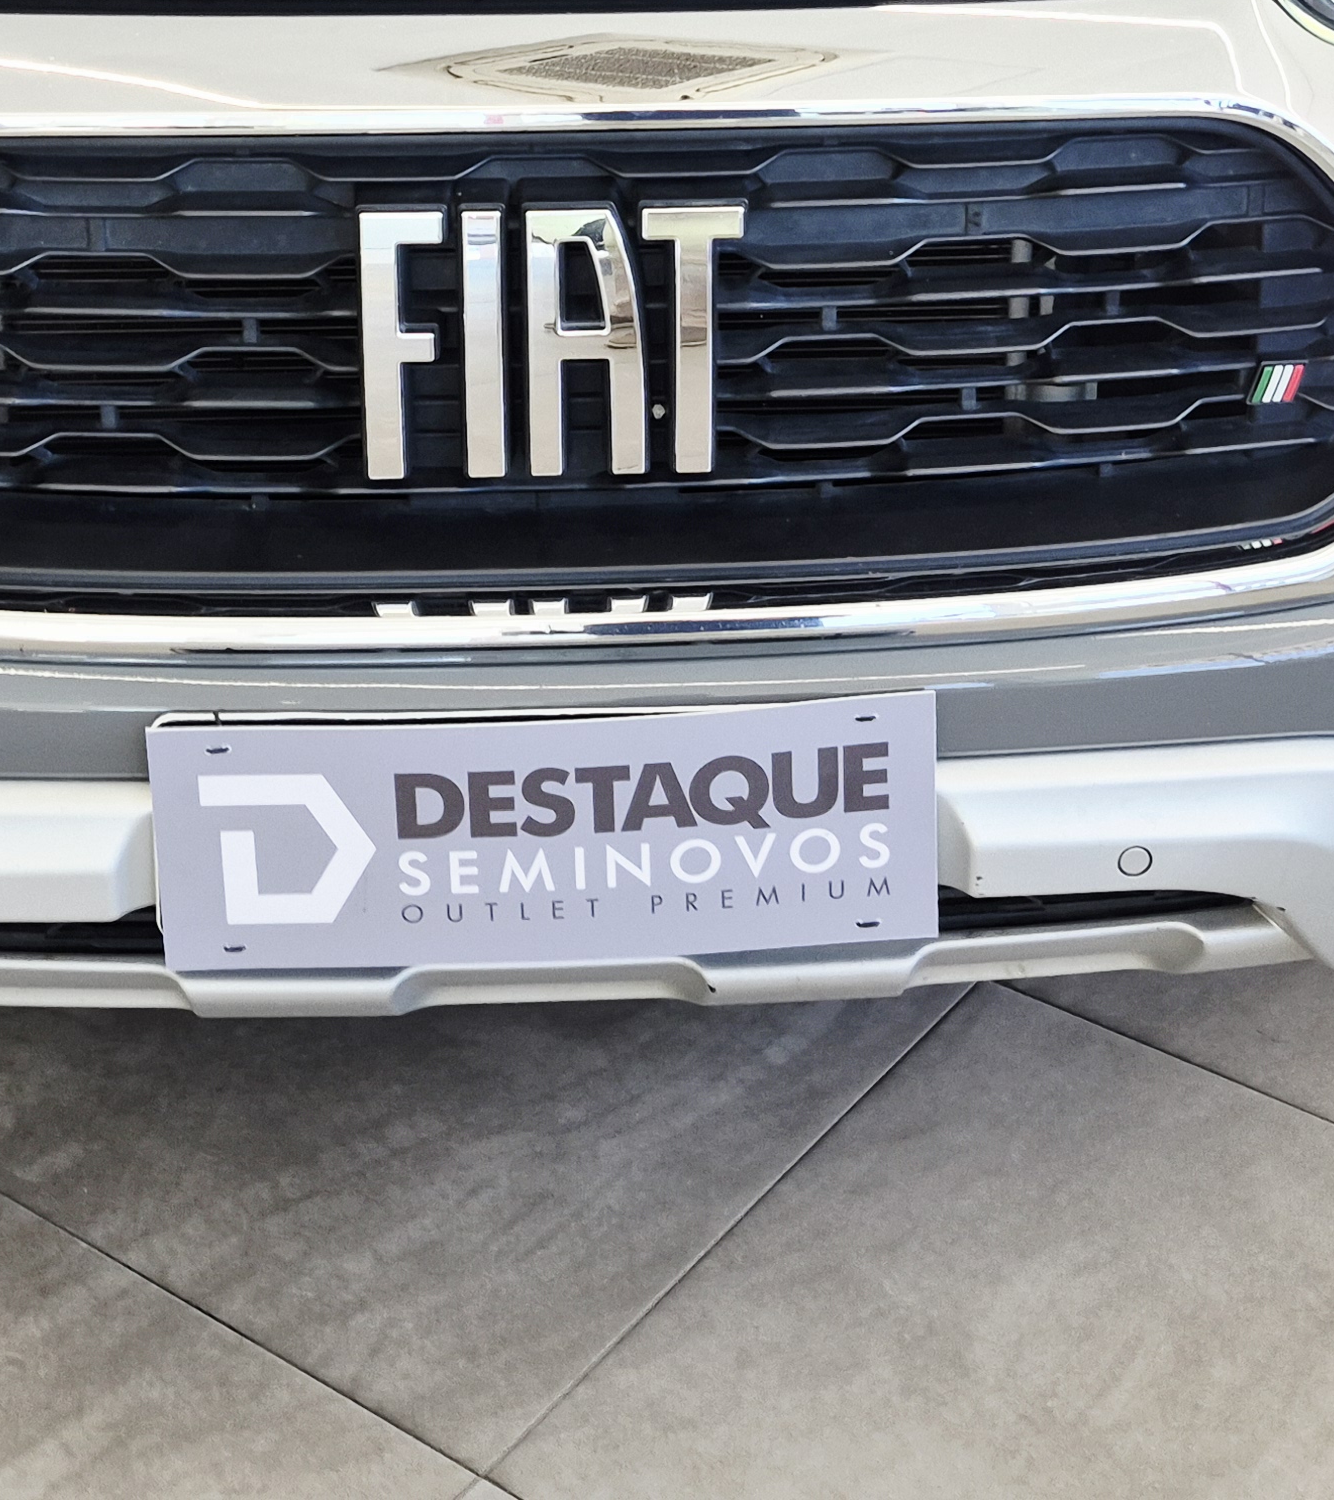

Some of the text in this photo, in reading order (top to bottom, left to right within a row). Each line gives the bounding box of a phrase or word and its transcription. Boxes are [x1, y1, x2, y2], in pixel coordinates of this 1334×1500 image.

[358, 204, 747, 480] FIAT
[393, 741, 890, 840] DESTAQUE
[398, 822, 891, 897] SEMINOVOS
[401, 877, 892, 924] OUTLET PREMIUM
